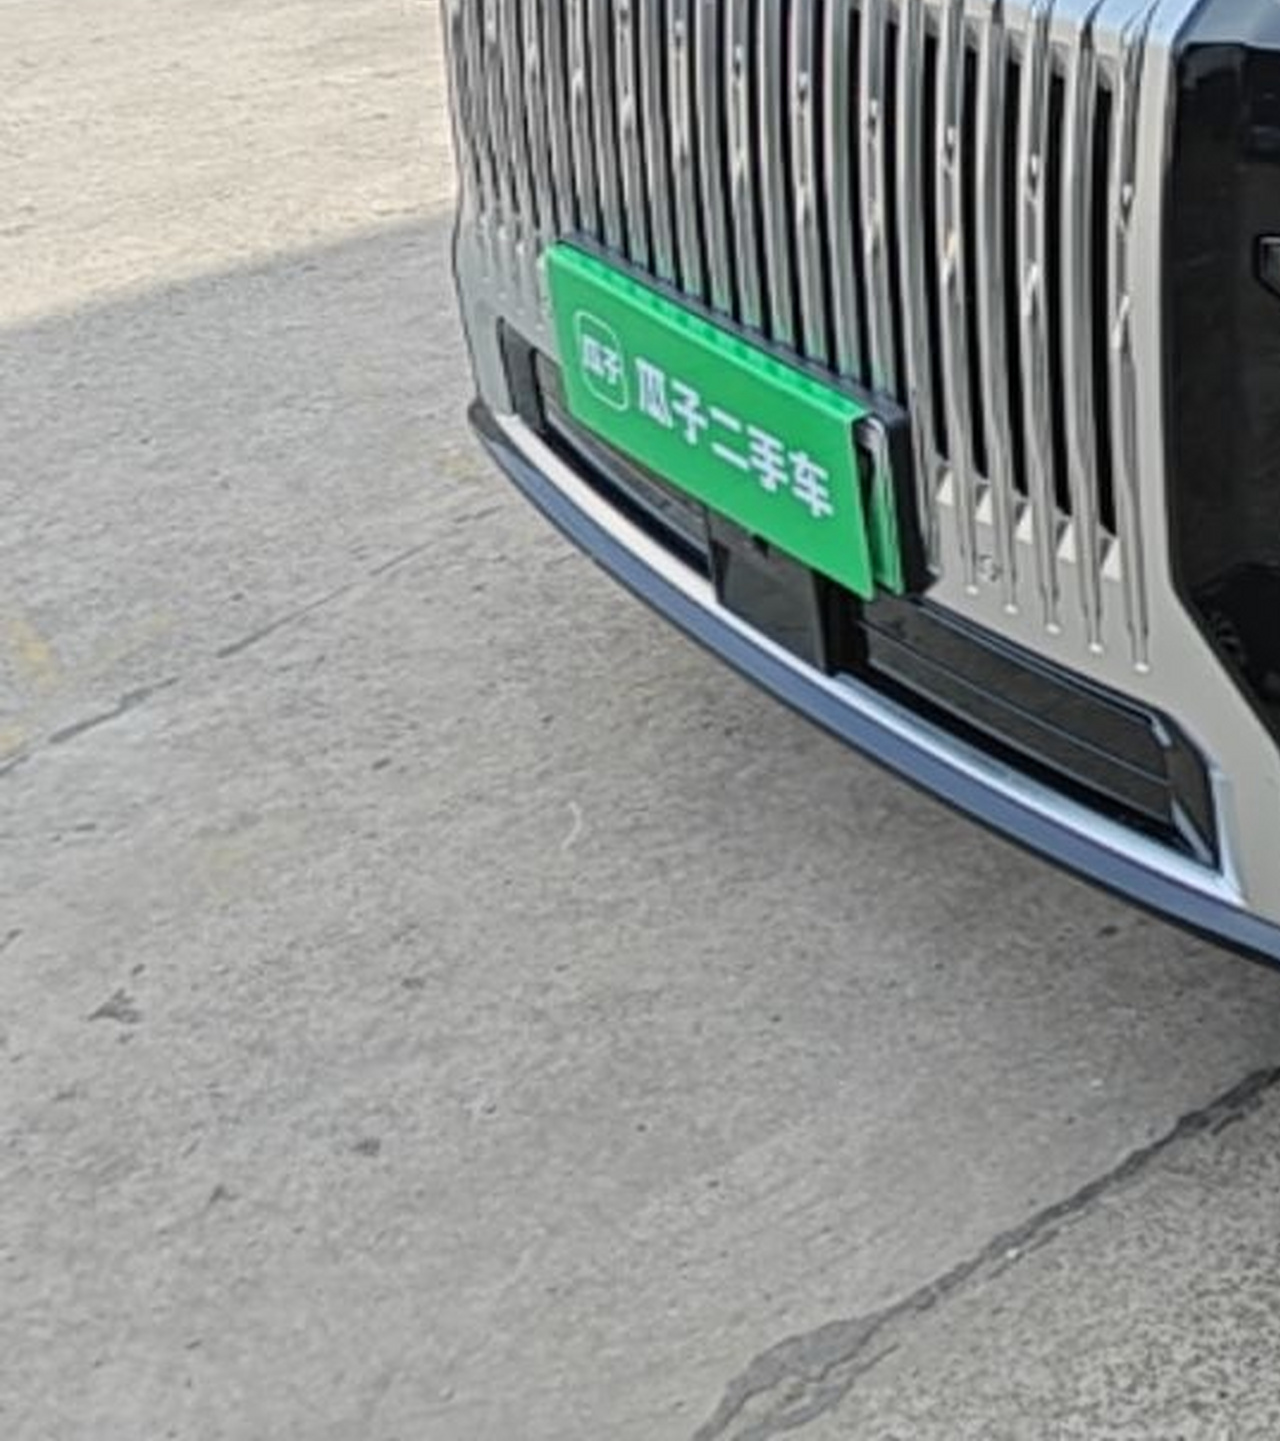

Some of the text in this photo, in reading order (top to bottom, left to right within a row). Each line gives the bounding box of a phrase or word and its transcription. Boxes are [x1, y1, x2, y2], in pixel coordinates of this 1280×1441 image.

[635, 357, 833, 518] 瓜子二手车
